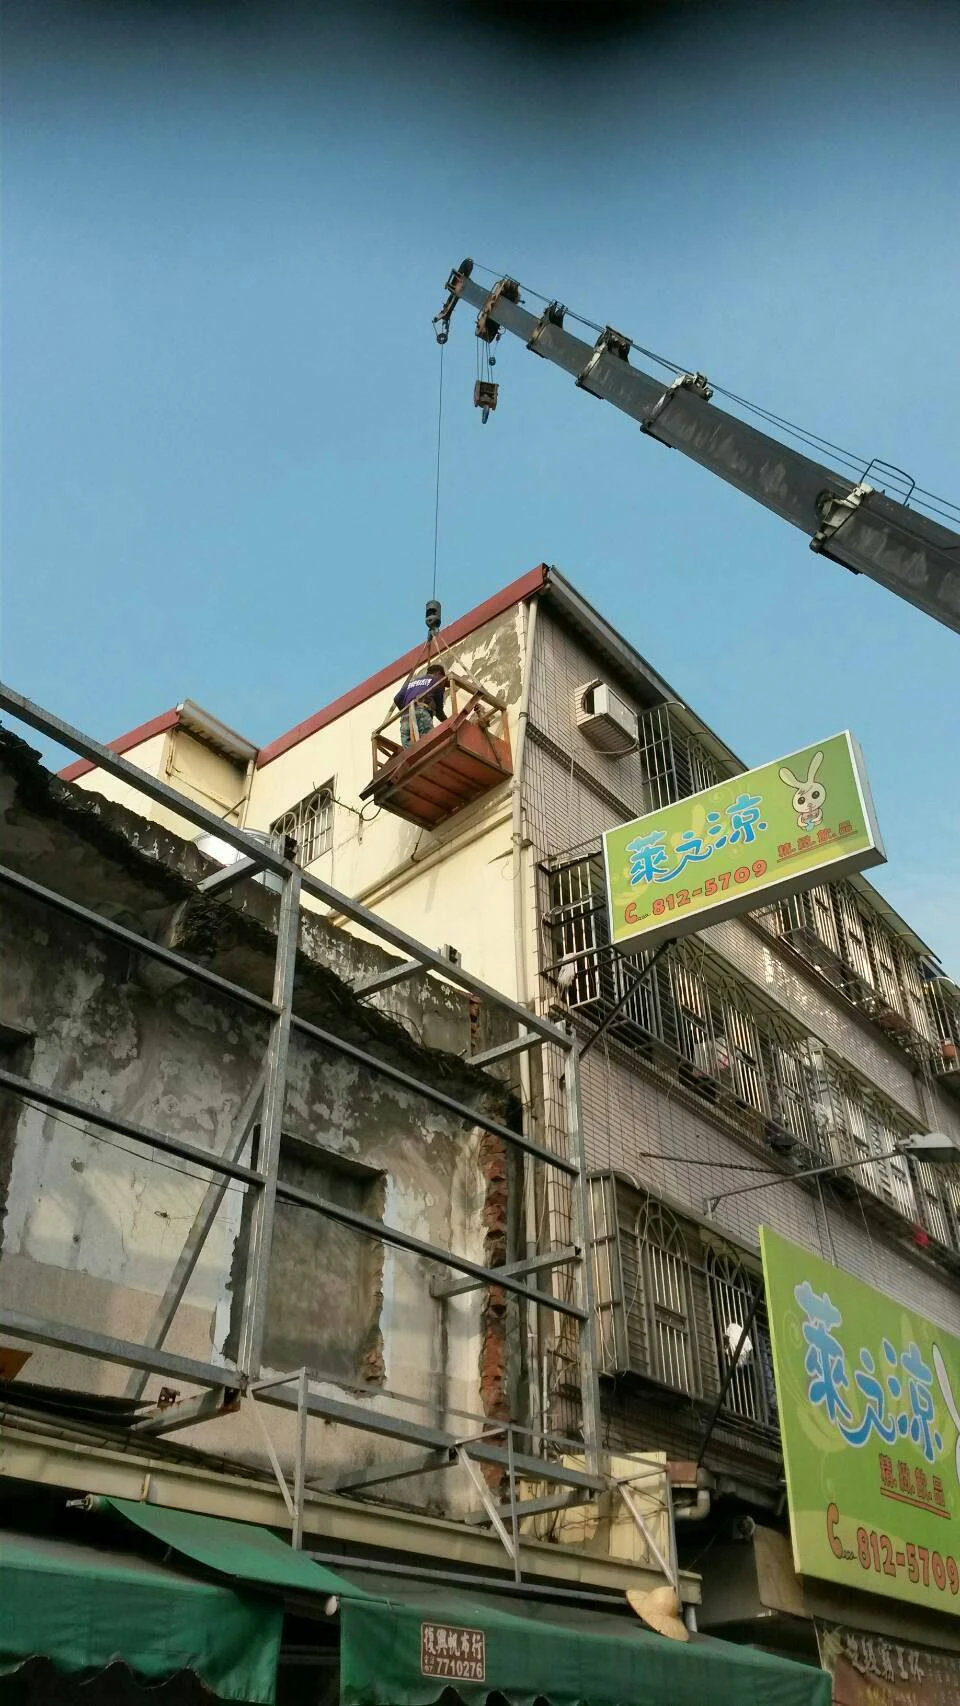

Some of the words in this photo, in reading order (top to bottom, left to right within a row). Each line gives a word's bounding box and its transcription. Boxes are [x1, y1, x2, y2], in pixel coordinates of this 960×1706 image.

[652, 859, 767, 916] 812-5709
[856, 1527, 960, 1596] 812-5709
[436, 1657, 483, 1679] 7710276
